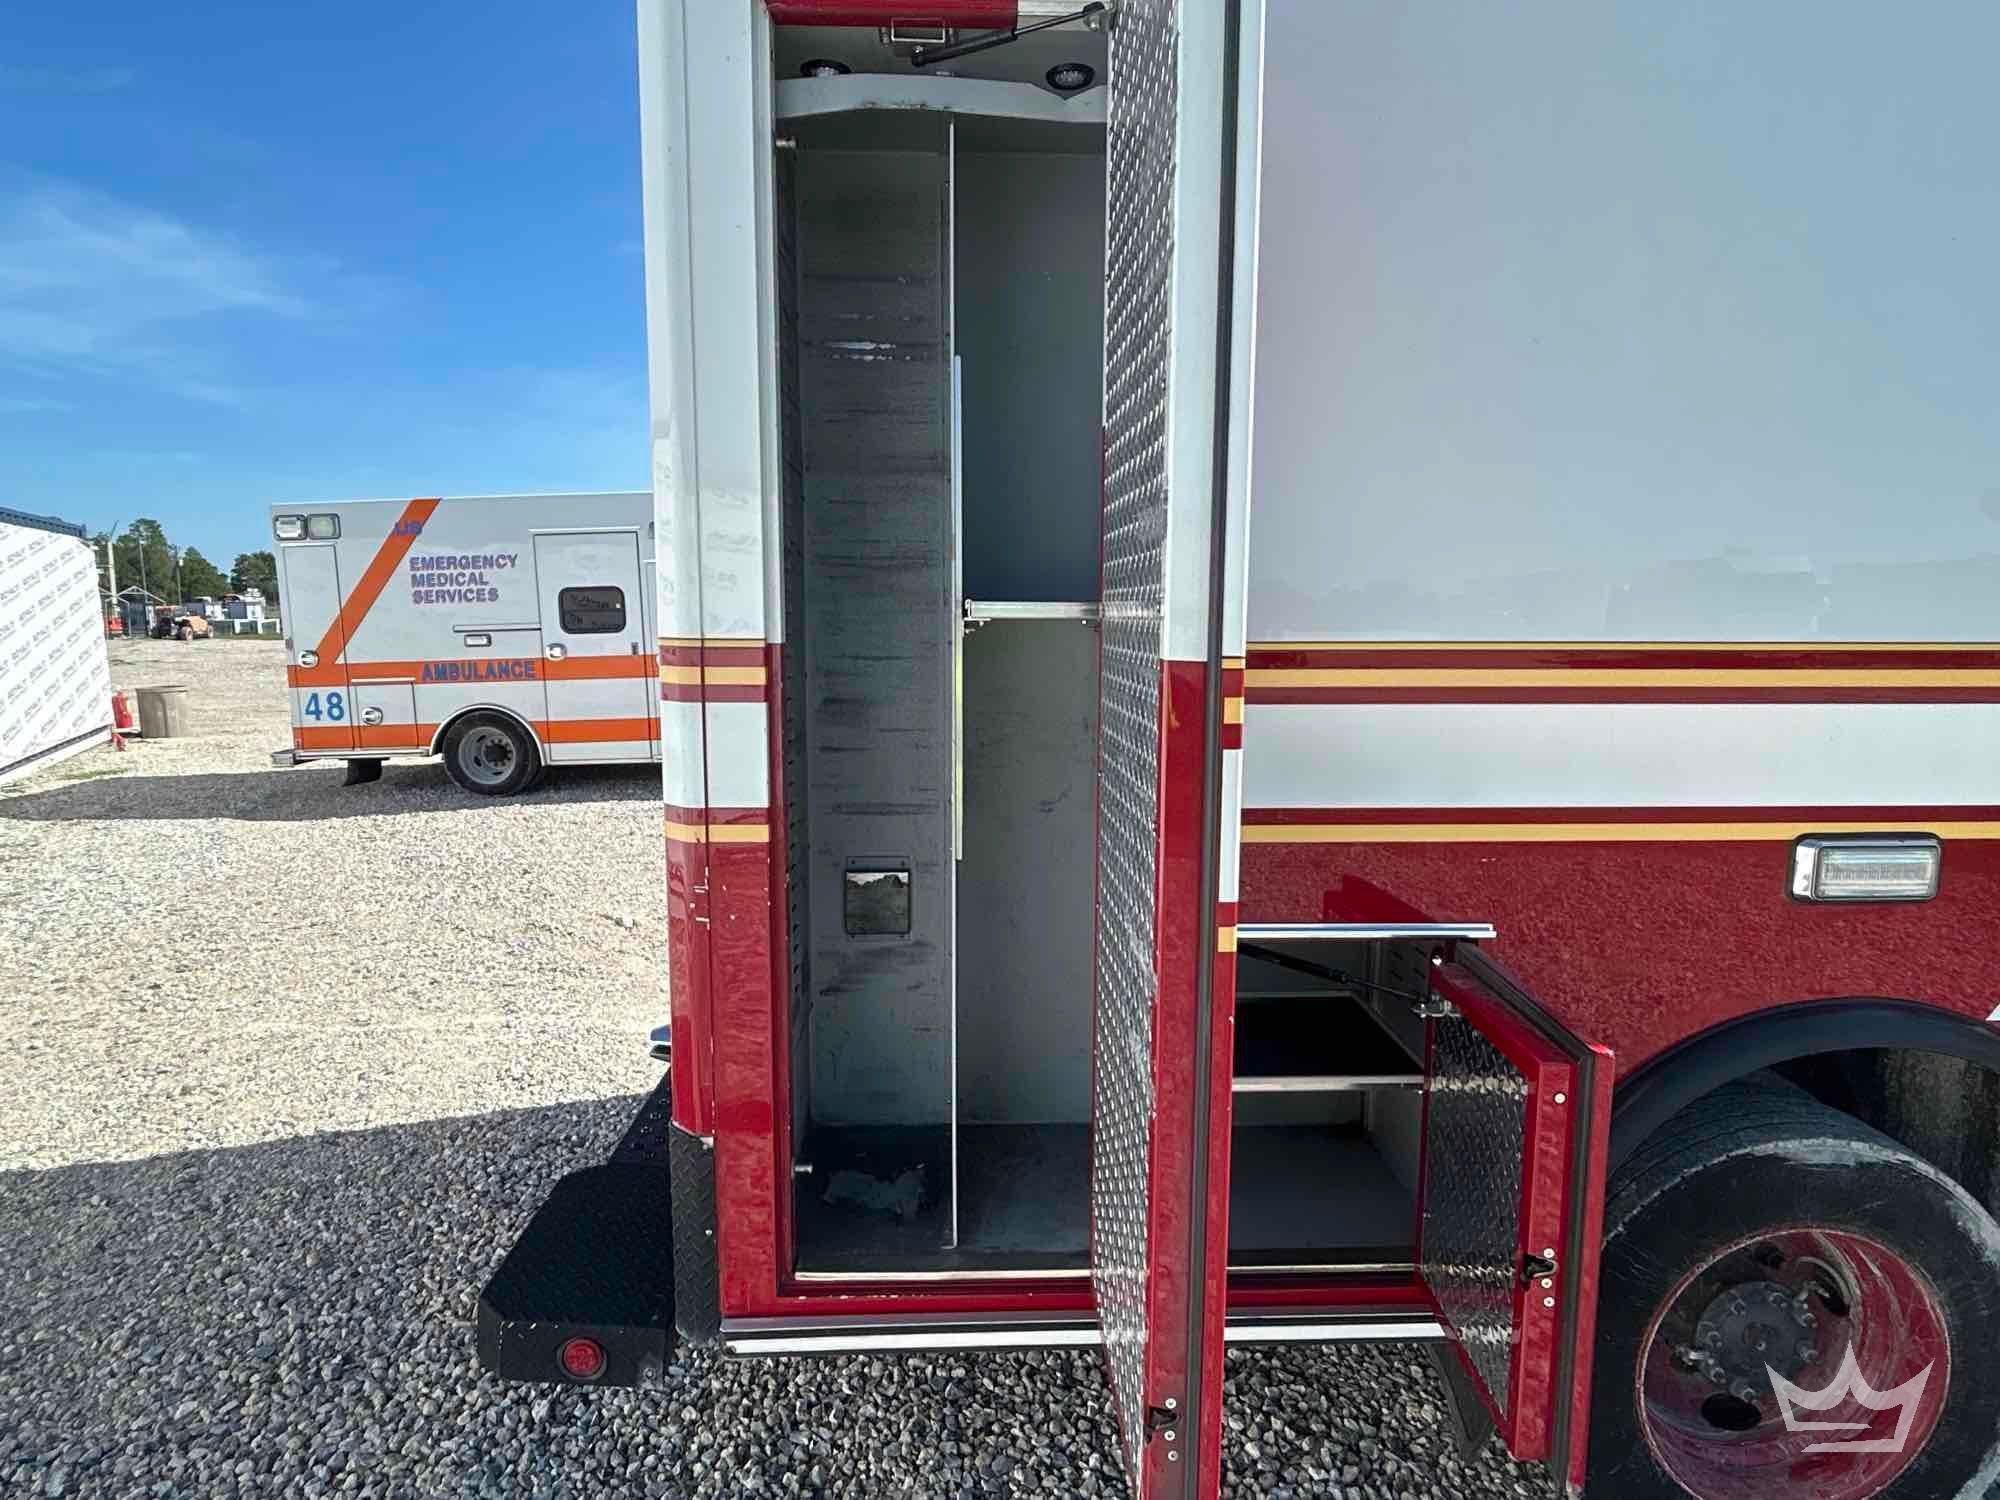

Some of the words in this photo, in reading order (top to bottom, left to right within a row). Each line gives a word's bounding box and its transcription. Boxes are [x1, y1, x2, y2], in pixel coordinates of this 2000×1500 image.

[409, 553, 518, 571] EMERGENCY
[411, 572, 489, 588] MEDICAL
[412, 588, 499, 604] SERVICES
[422, 660, 537, 681] AMBULANCE
[305, 692, 345, 721] 48
